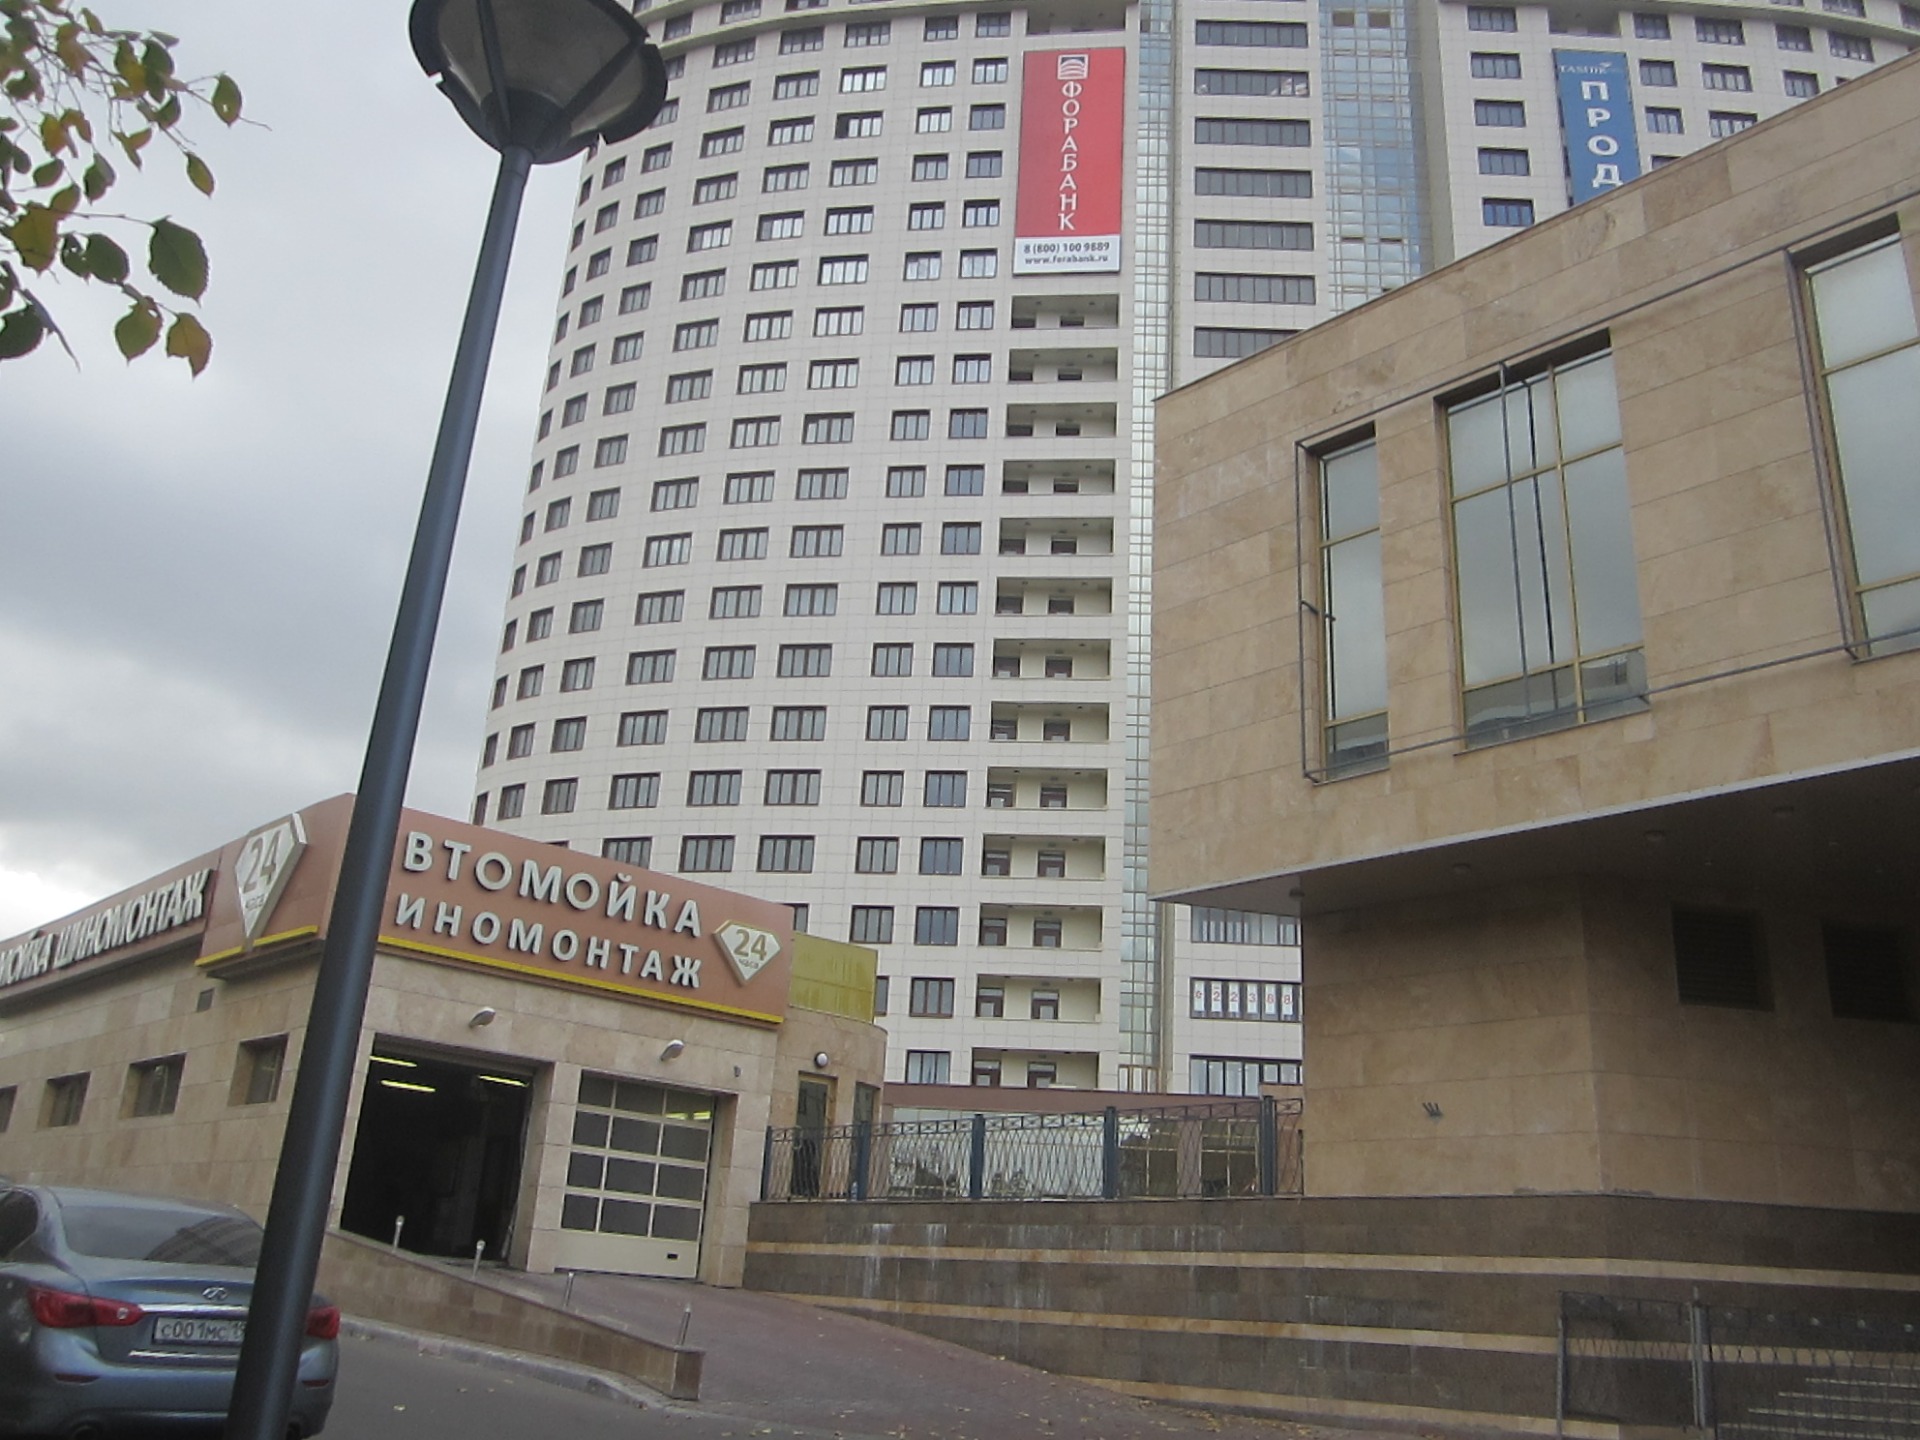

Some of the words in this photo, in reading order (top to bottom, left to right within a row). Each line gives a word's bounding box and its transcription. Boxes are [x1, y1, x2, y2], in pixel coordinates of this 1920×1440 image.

[1057, 81, 1083, 231] ФОРАБАНК
[1580, 80, 1624, 188] ПРОД
[1023, 243, 1031, 254] 8
[1032, 243, 1060, 255] (800)
[1062, 242, 1082, 252] 100
[242, 829, 282, 894] 24
[403, 830, 702, 938] ВТОМОЙКА
[53, 868, 214, 970] ШИНОМОНТАЖ
[395, 893, 702, 989] ИНОМОНТАЖ
[733, 928, 768, 962] 24
